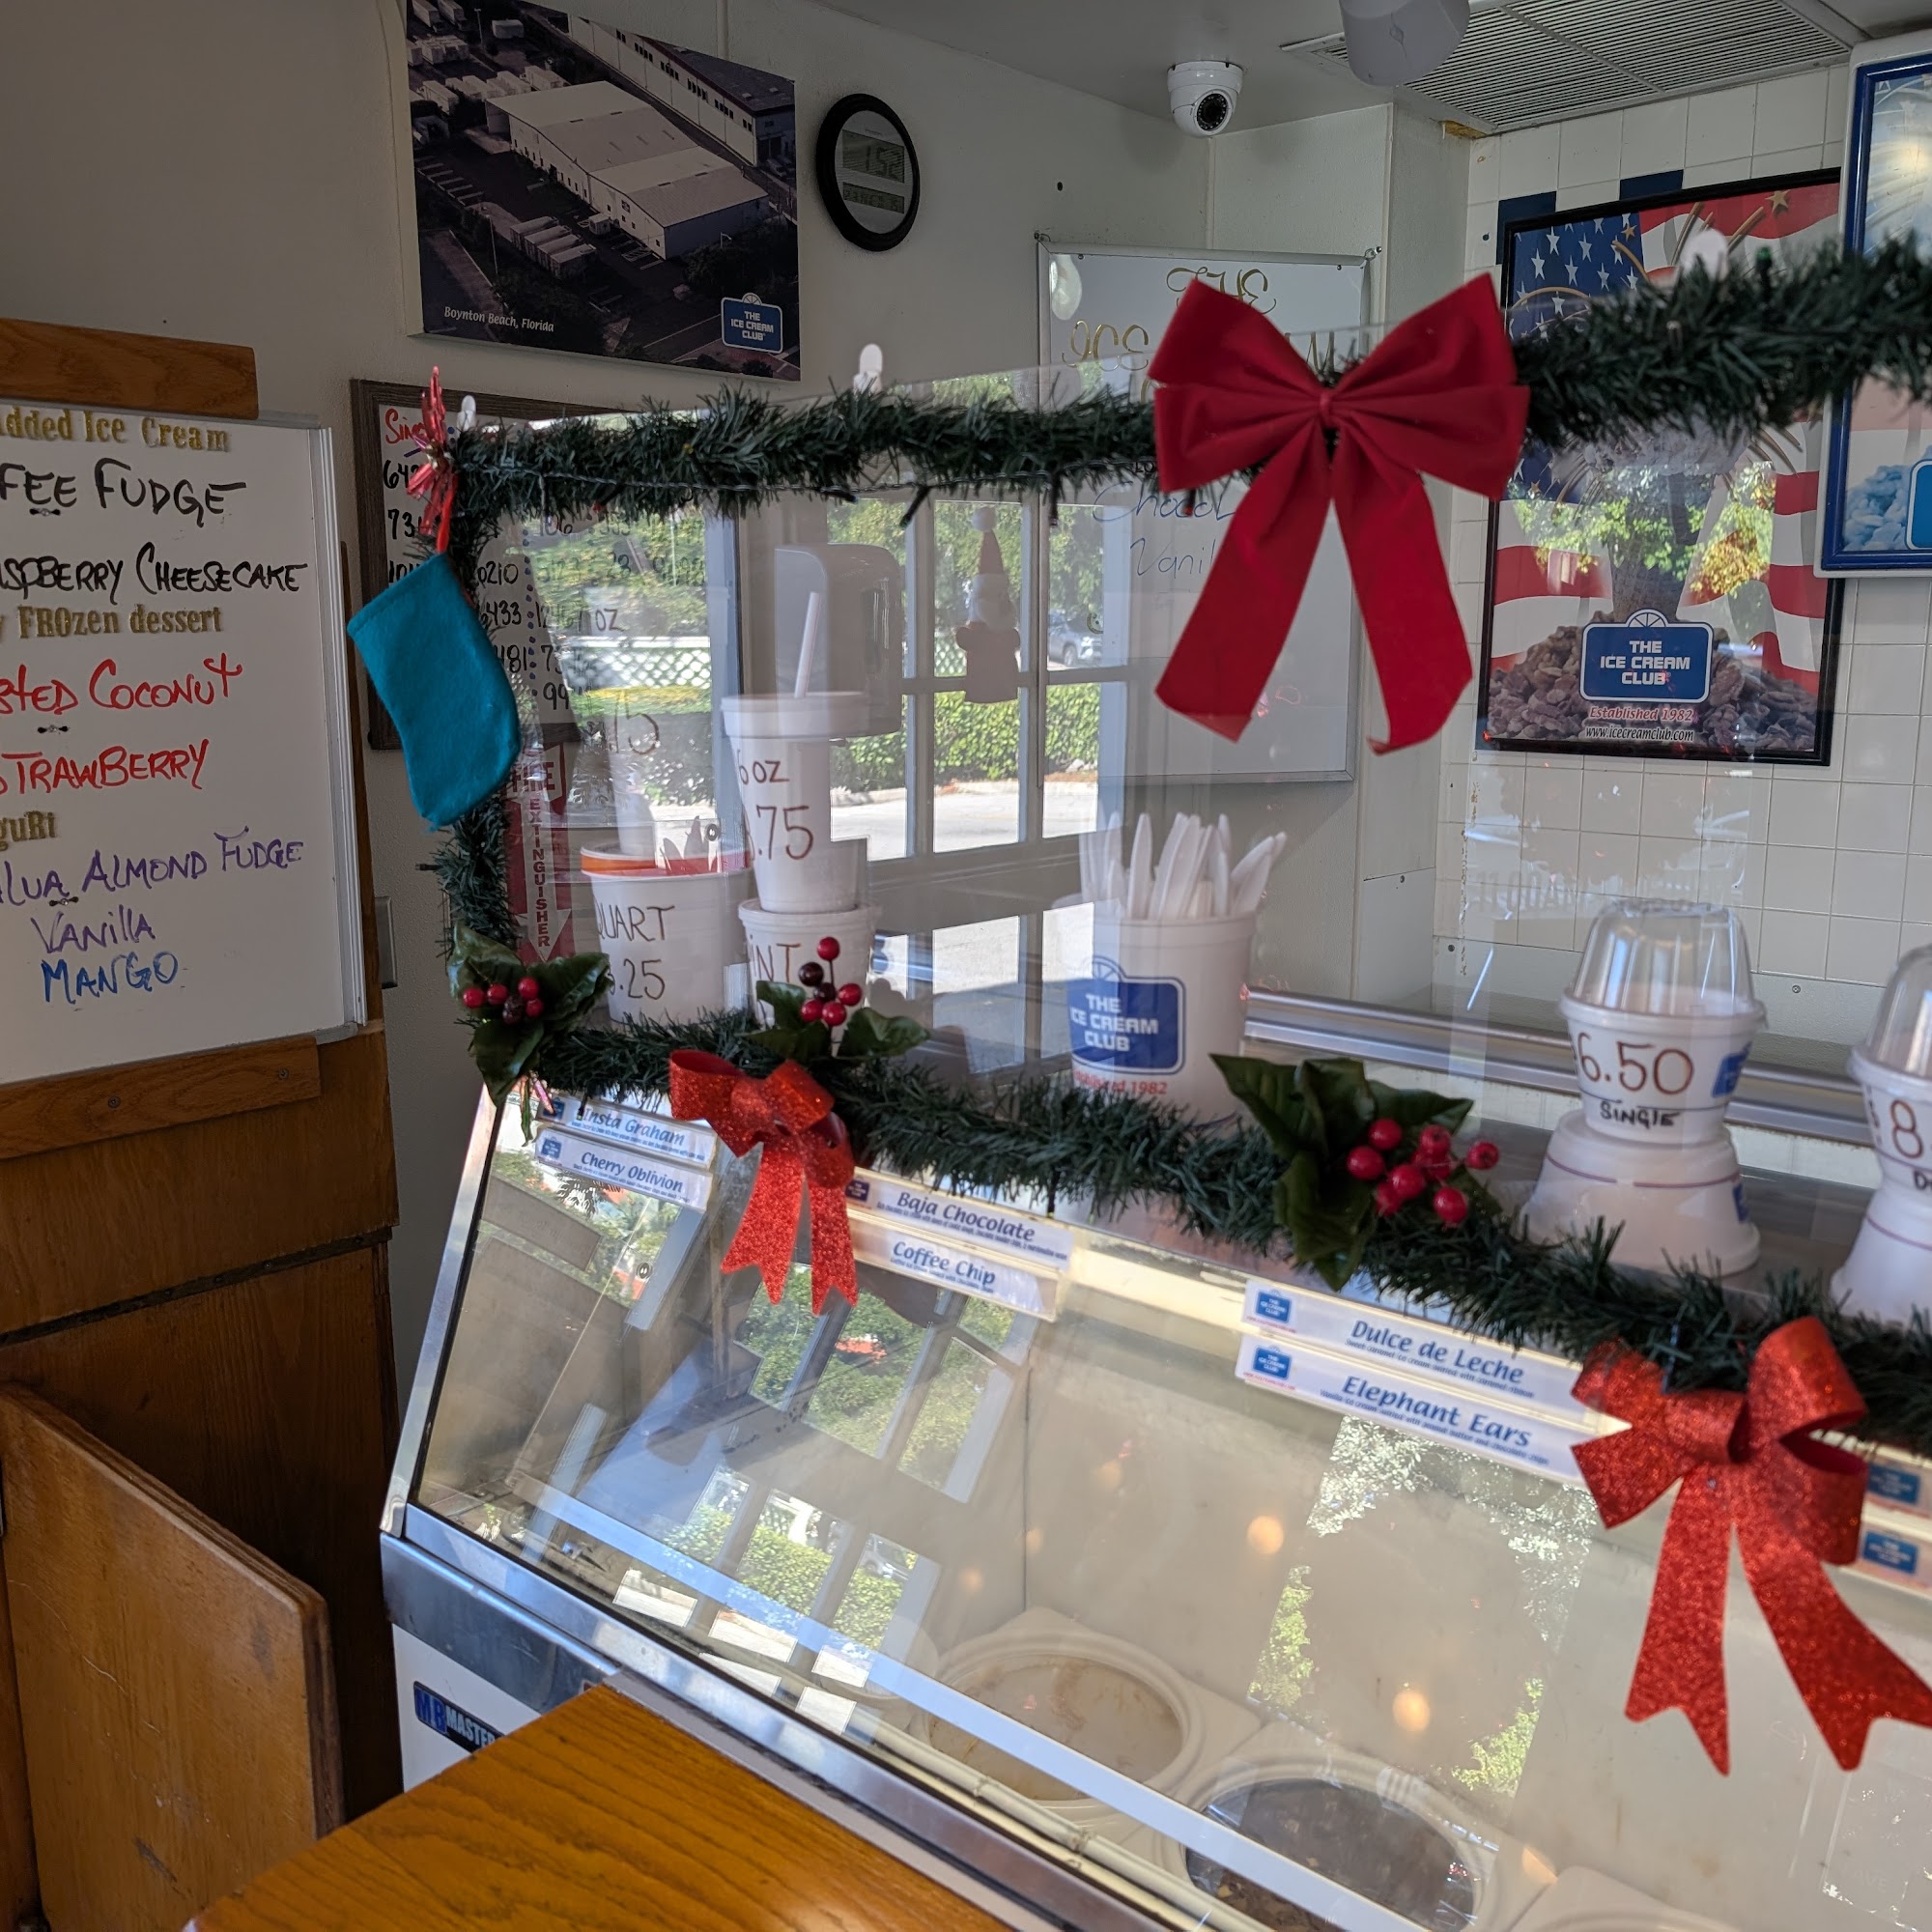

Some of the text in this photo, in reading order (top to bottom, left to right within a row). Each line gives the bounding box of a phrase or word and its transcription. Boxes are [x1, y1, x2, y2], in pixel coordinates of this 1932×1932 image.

[444, 306, 554, 332] Boynton Beach, Florida
[730, 319, 774, 333] ICE CREAM
[744, 311, 761, 322] THE
[742, 330, 764, 341] CLUB
[0, 406, 230, 452] dded Ice Cream
[1130, 537, 1217, 580] Vanil
[128, 604, 222, 634] dessert
[1629, 639, 1662, 654] THE
[1600, 655, 1690, 670] ICE CREAM
[1621, 671, 1666, 686] CLUB
[1589, 706, 1694, 722] Established 1982
[1585, 725, 1694, 742] www.icecreamclub.com
[528, 798, 551, 948] EXTINGUISHER
[1085, 993, 1122, 1014] THE
[1090, 1013, 1159, 1036] CREAM
[1084, 1030, 1131, 1052] CLUB
[1577, 1032, 1694, 1095] 6.50
[1131, 1081, 1168, 1094] 1982
[582, 1107, 621, 1129] Insta
[625, 1119, 685, 1147] Graham
[581, 1151, 625, 1177] Cherry
[628, 1165, 684, 1194] Oblivion
[896, 1191, 939, 1215] Baja
[943, 1204, 1036, 1242] Chocolate
[893, 1241, 996, 1286] Coffee Chip
[1351, 1320, 1524, 1384] Dulce de Leche
[1342, 1375, 1461, 1427] Elephant
[1469, 1412, 1532, 1447] Ears
